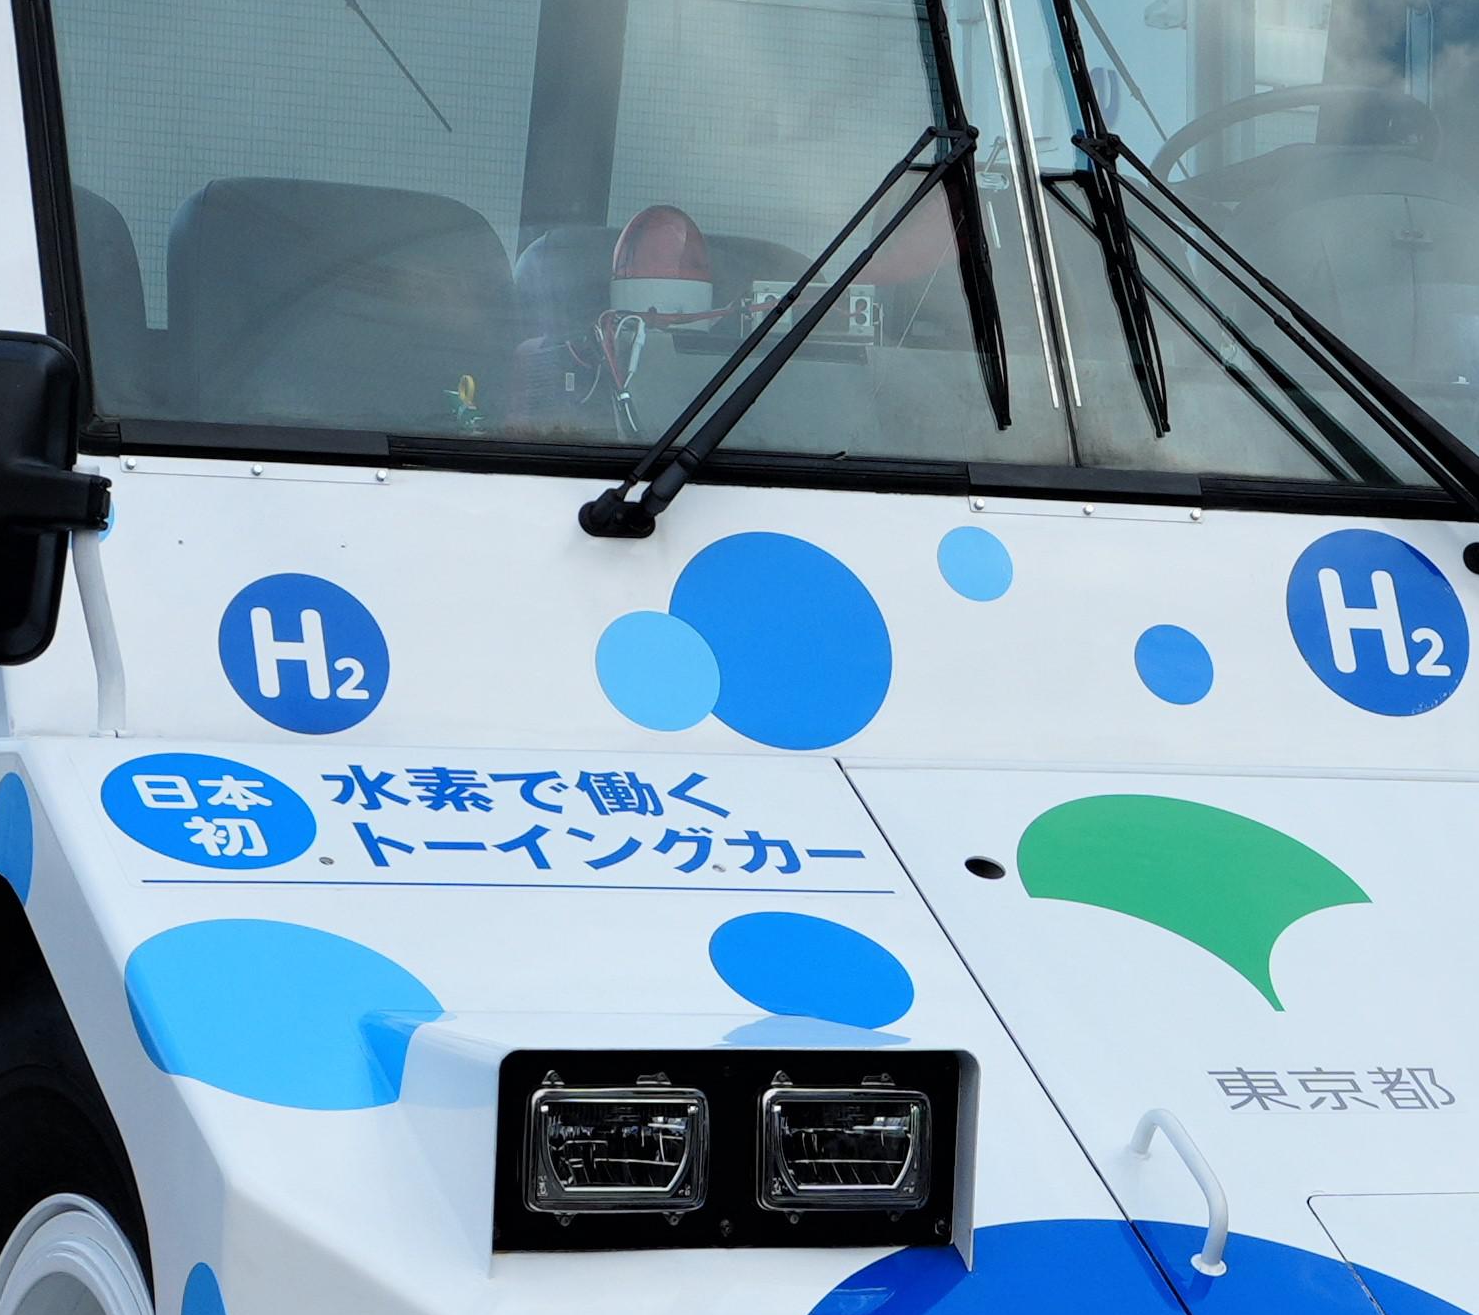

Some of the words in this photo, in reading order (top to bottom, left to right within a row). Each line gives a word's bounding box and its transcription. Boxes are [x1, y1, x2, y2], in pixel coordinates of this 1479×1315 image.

[1318, 567, 1451, 677] H2
[250, 606, 370, 702] H2
[132, 773, 273, 810] 日本
[321, 765, 731, 819] 水素で働く
[189, 816, 269, 858] 初
[353, 820, 866, 874] トーイングカー
[1209, 1067, 1456, 1112] 東京都
